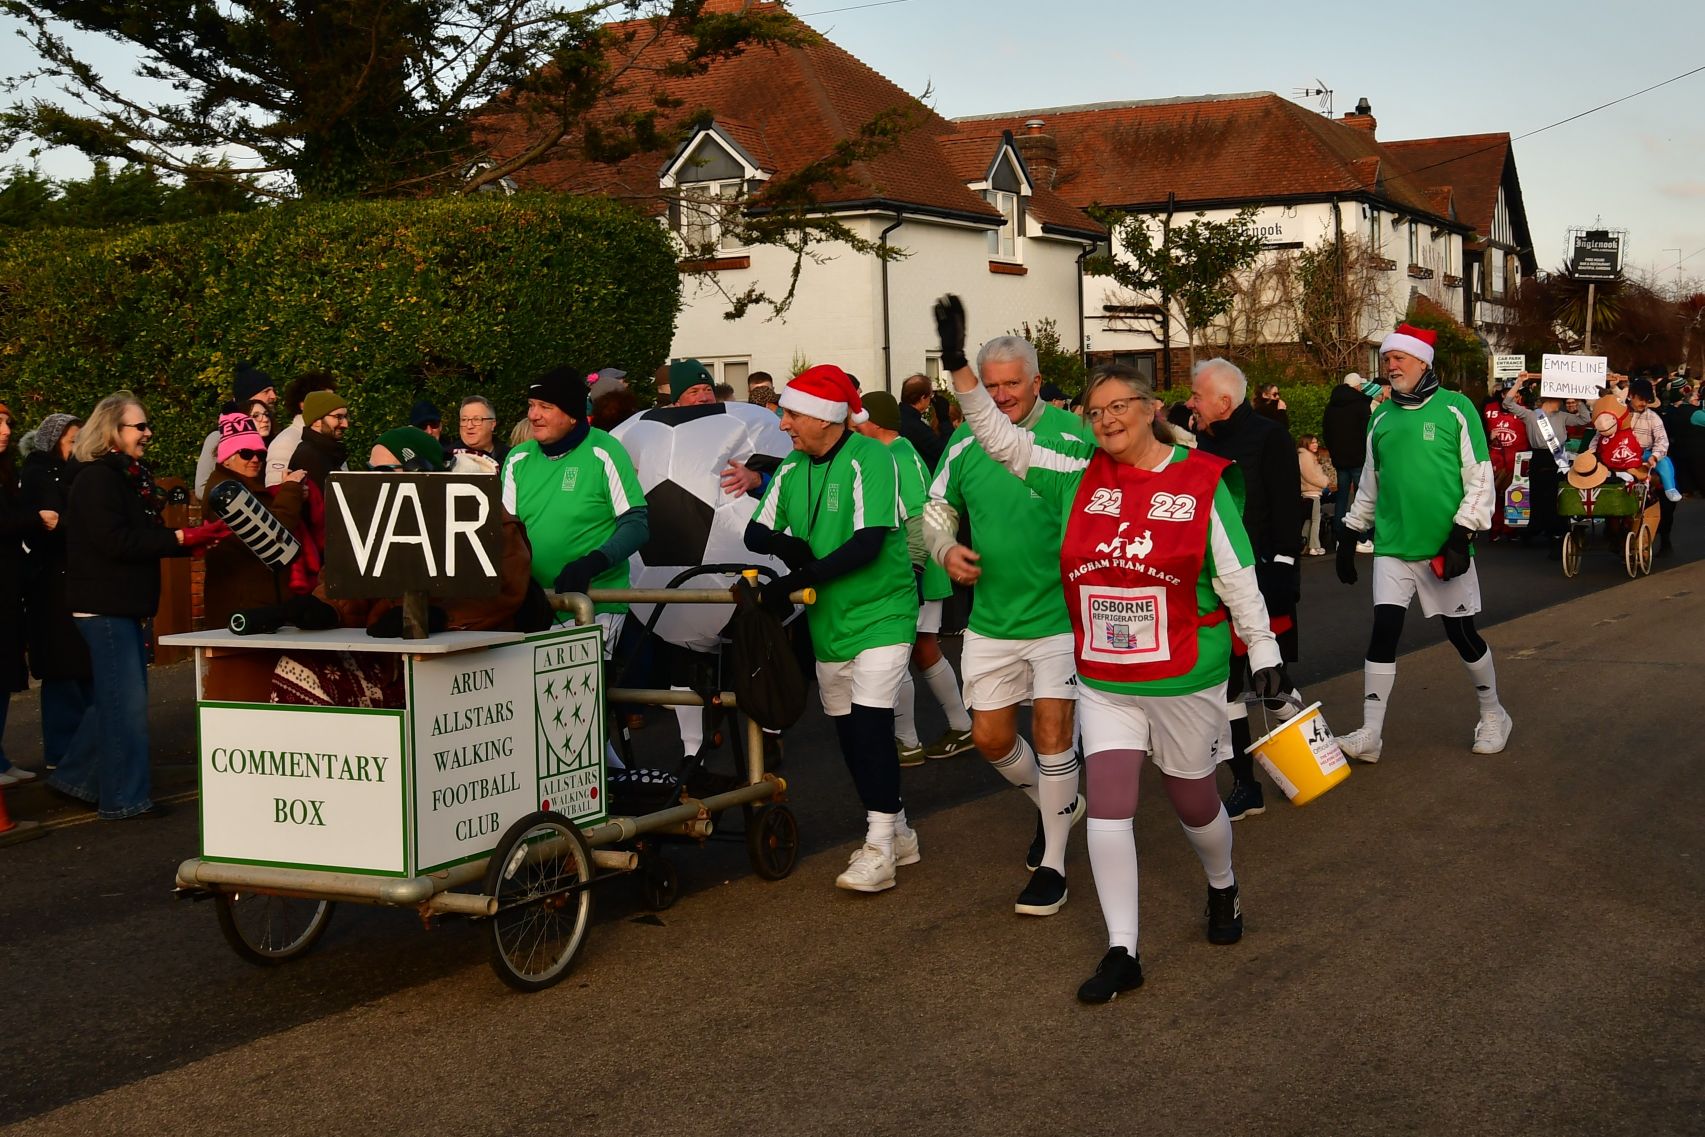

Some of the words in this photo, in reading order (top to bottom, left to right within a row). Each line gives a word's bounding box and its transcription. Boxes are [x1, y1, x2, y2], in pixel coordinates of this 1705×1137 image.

[1575, 239, 1618, 249] Inglenook
[1544, 358, 1605, 374] EMMELINE
[1543, 381, 1598, 395] PRAMHURS
[1486, 410, 1499, 418] 15
[1084, 488, 1122, 518] 22
[1147, 492, 1196, 522] 22
[332, 482, 498, 577] VAR
[1068, 559, 1110, 582] PAGHAM
[1112, 559, 1146, 572] PRAM
[1148, 566, 1181, 586] RACE
[1092, 599, 1154, 613] OSBORNE
[1092, 612, 1154, 622] REFRIGERATORS
[543, 642, 590, 668] ARUN
[450, 668, 495, 696] ARUN
[431, 700, 514, 737] ALLSTARS
[211, 747, 389, 783] COMMENTARY
[433, 736, 514, 774] WALKING
[432, 771, 521, 812] FOOTBALL
[542, 769, 598, 797] ALLSTARS
[550, 788, 590, 808] WALKING
[554, 800, 592, 816] OOTBALL
[273, 798, 327, 827] BOX
[456, 812, 500, 842] CLUB
